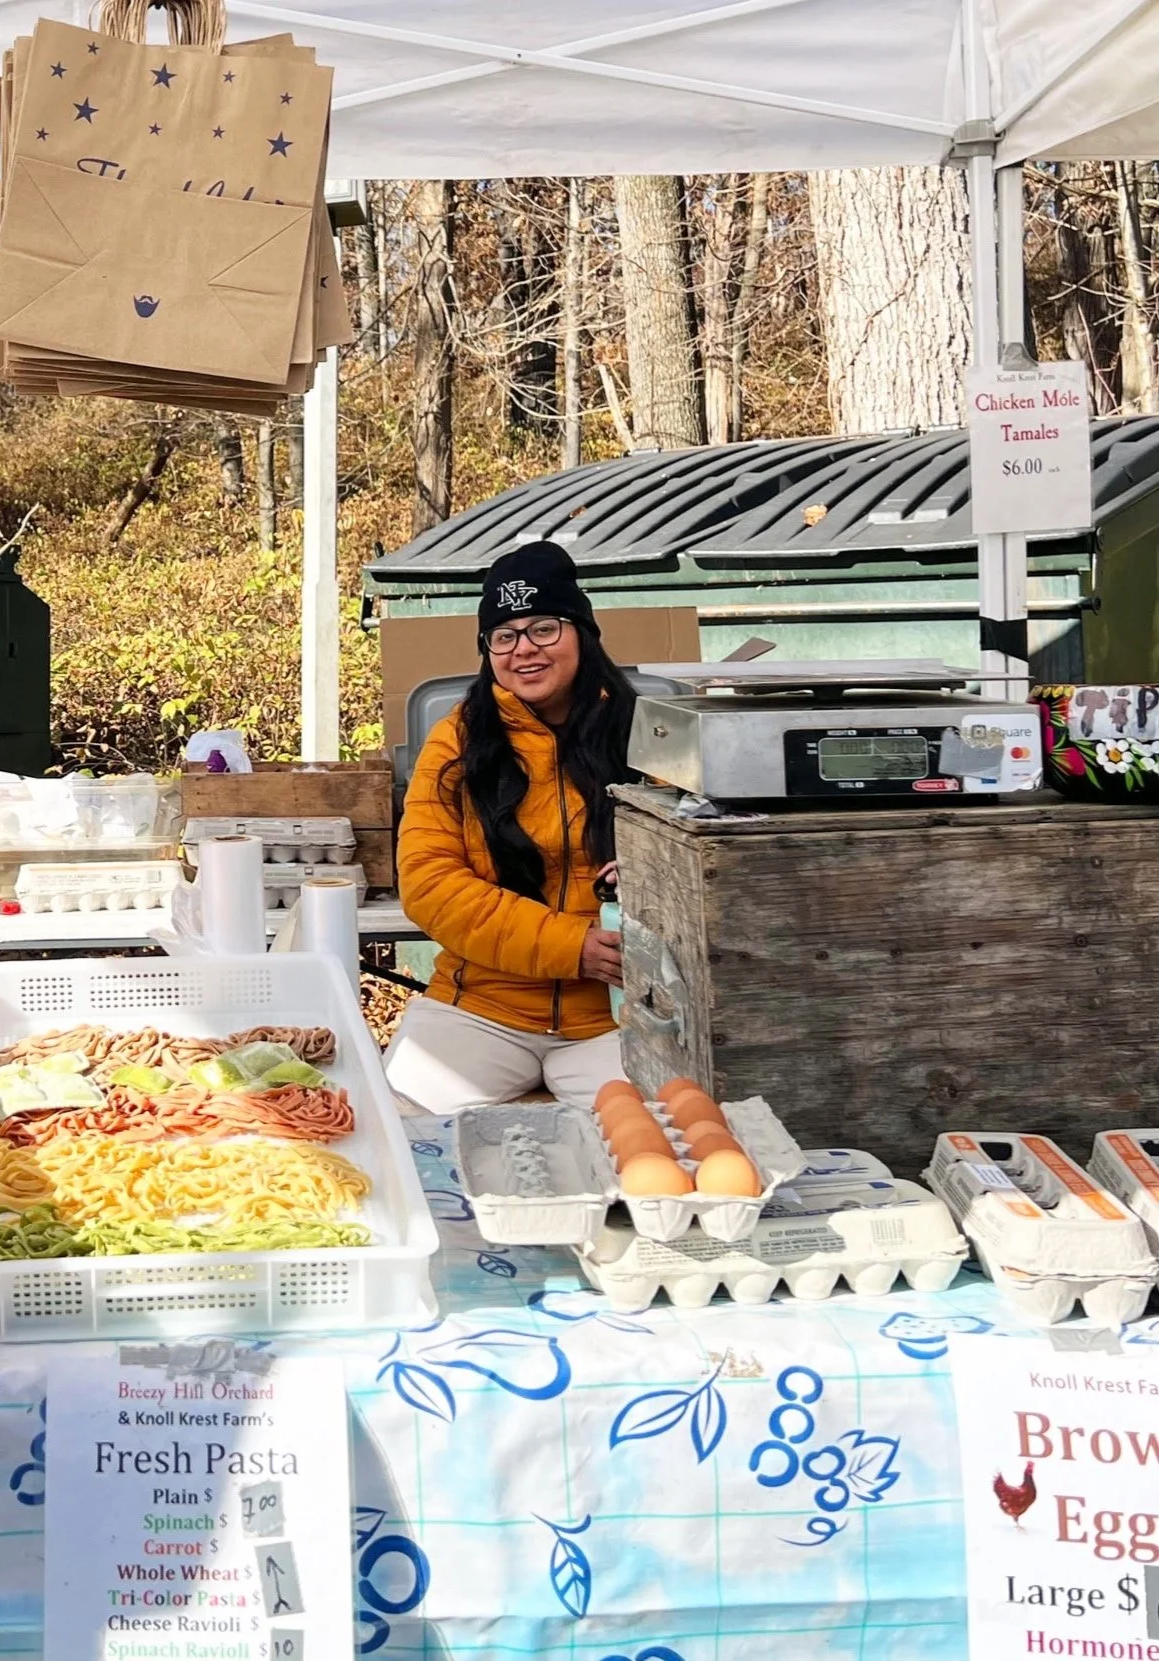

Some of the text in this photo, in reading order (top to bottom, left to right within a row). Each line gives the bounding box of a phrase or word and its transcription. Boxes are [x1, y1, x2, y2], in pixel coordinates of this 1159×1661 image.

[975, 393, 1035, 412] Chicken
[1001, 423, 1059, 442] Tamales
[1002, 458, 1042, 477] $6.00
[497, 580, 538, 611] NY
[1029, 1372, 1077, 1390] Knoll
[1083, 1375, 1132, 1394] Krest
[118, 1381, 274, 1408] Breezy Hill Orchard
[118, 1411, 130, 1426] &
[135, 1411, 174, 1426] Knoll
[179, 1411, 218, 1426] Krest
[94, 1441, 299, 1476] Fresh Pasta
[153, 1487, 213, 1505] Plain $
[143, 1513, 228, 1535] Spinach $
[144, 1538, 219, 1556] Carrot $
[117, 1564, 176, 1581] Whole
[181, 1564, 239, 1581] Wheat
[108, 1589, 192, 1606] Tri-Color
[197, 1590, 246, 1607] Pasta
[1005, 1575, 1105, 1617] Large
[1117, 1573, 1140, 1616] $
[108, 1615, 172, 1631] Cheese
[178, 1616, 241, 1632] Ravioli
[108, 1640, 180, 1660] Spinach
[186, 1640, 250, 1658] Ravioli
